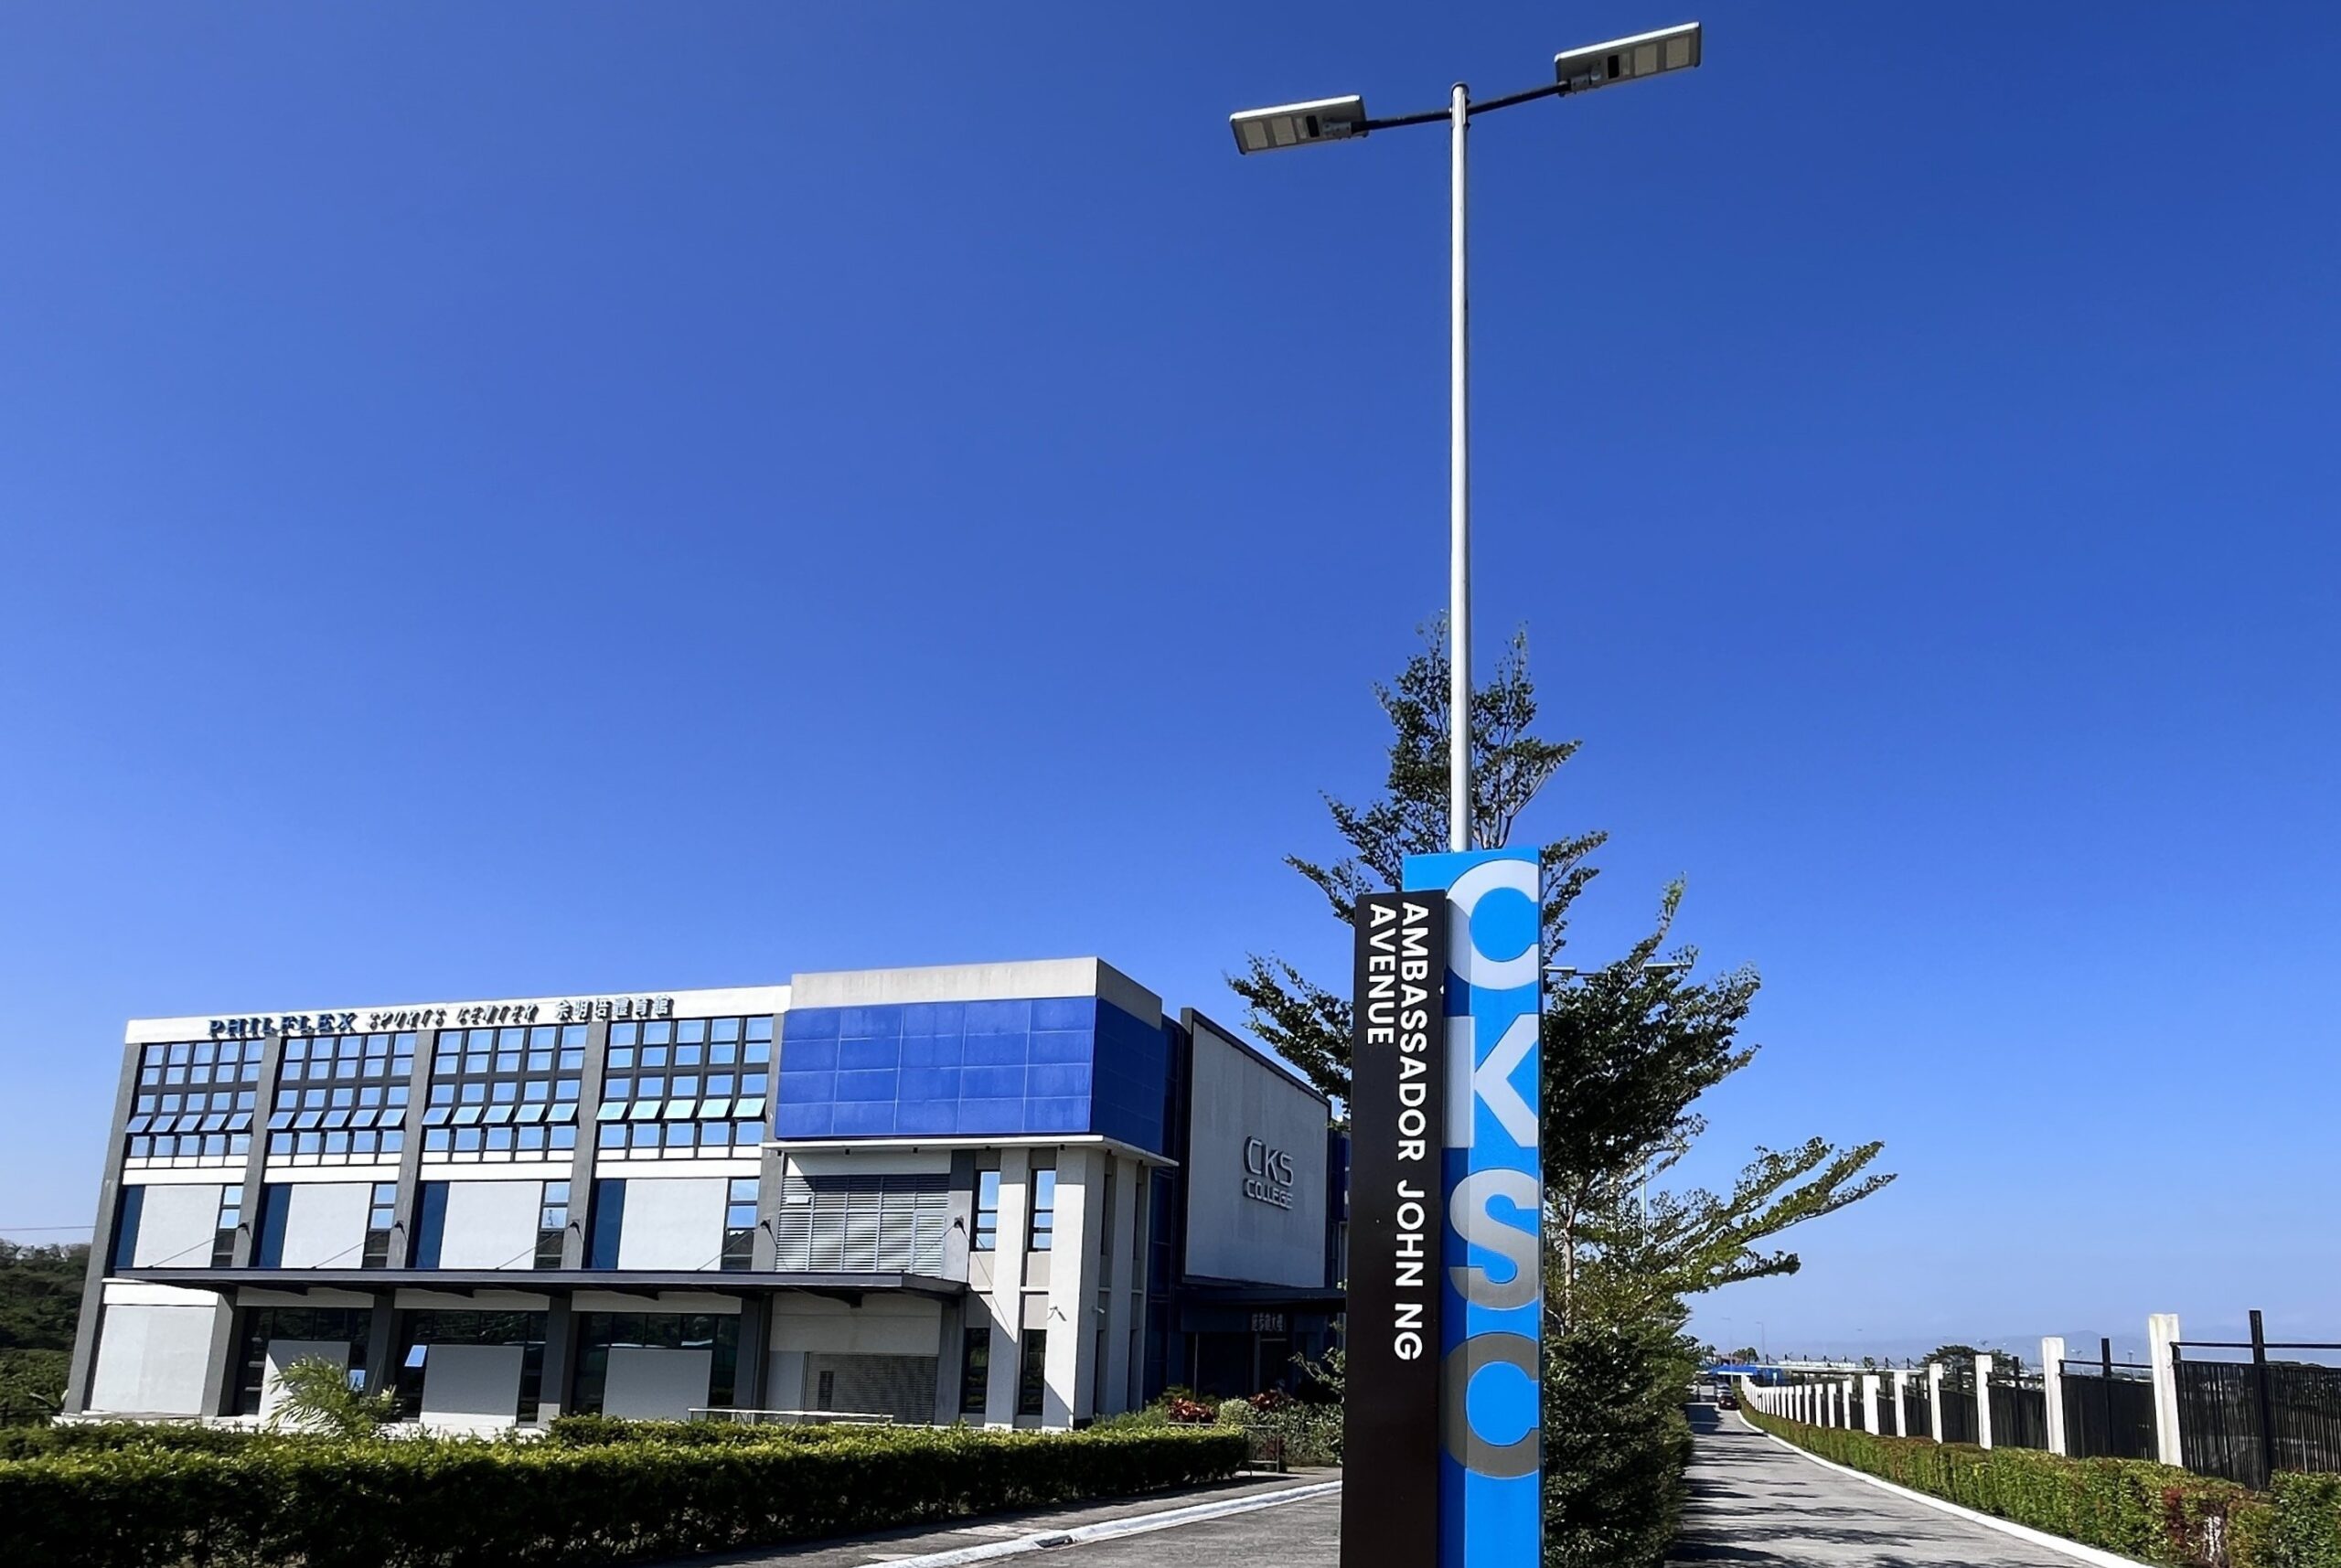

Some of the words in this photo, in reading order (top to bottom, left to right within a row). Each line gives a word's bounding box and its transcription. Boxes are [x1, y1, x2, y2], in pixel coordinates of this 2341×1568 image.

[1367, 903, 1396, 1045] AVENUE
[208, 1012, 358, 1039] PHILFLEX
[1397, 901, 1429, 1162] AMBASSADOR
[1244, 1136, 1295, 1188] CKS
[1243, 1178, 1295, 1211] COLLEGE
[1395, 1179, 1427, 1287] JOHN
[1394, 1303, 1424, 1360] NG
